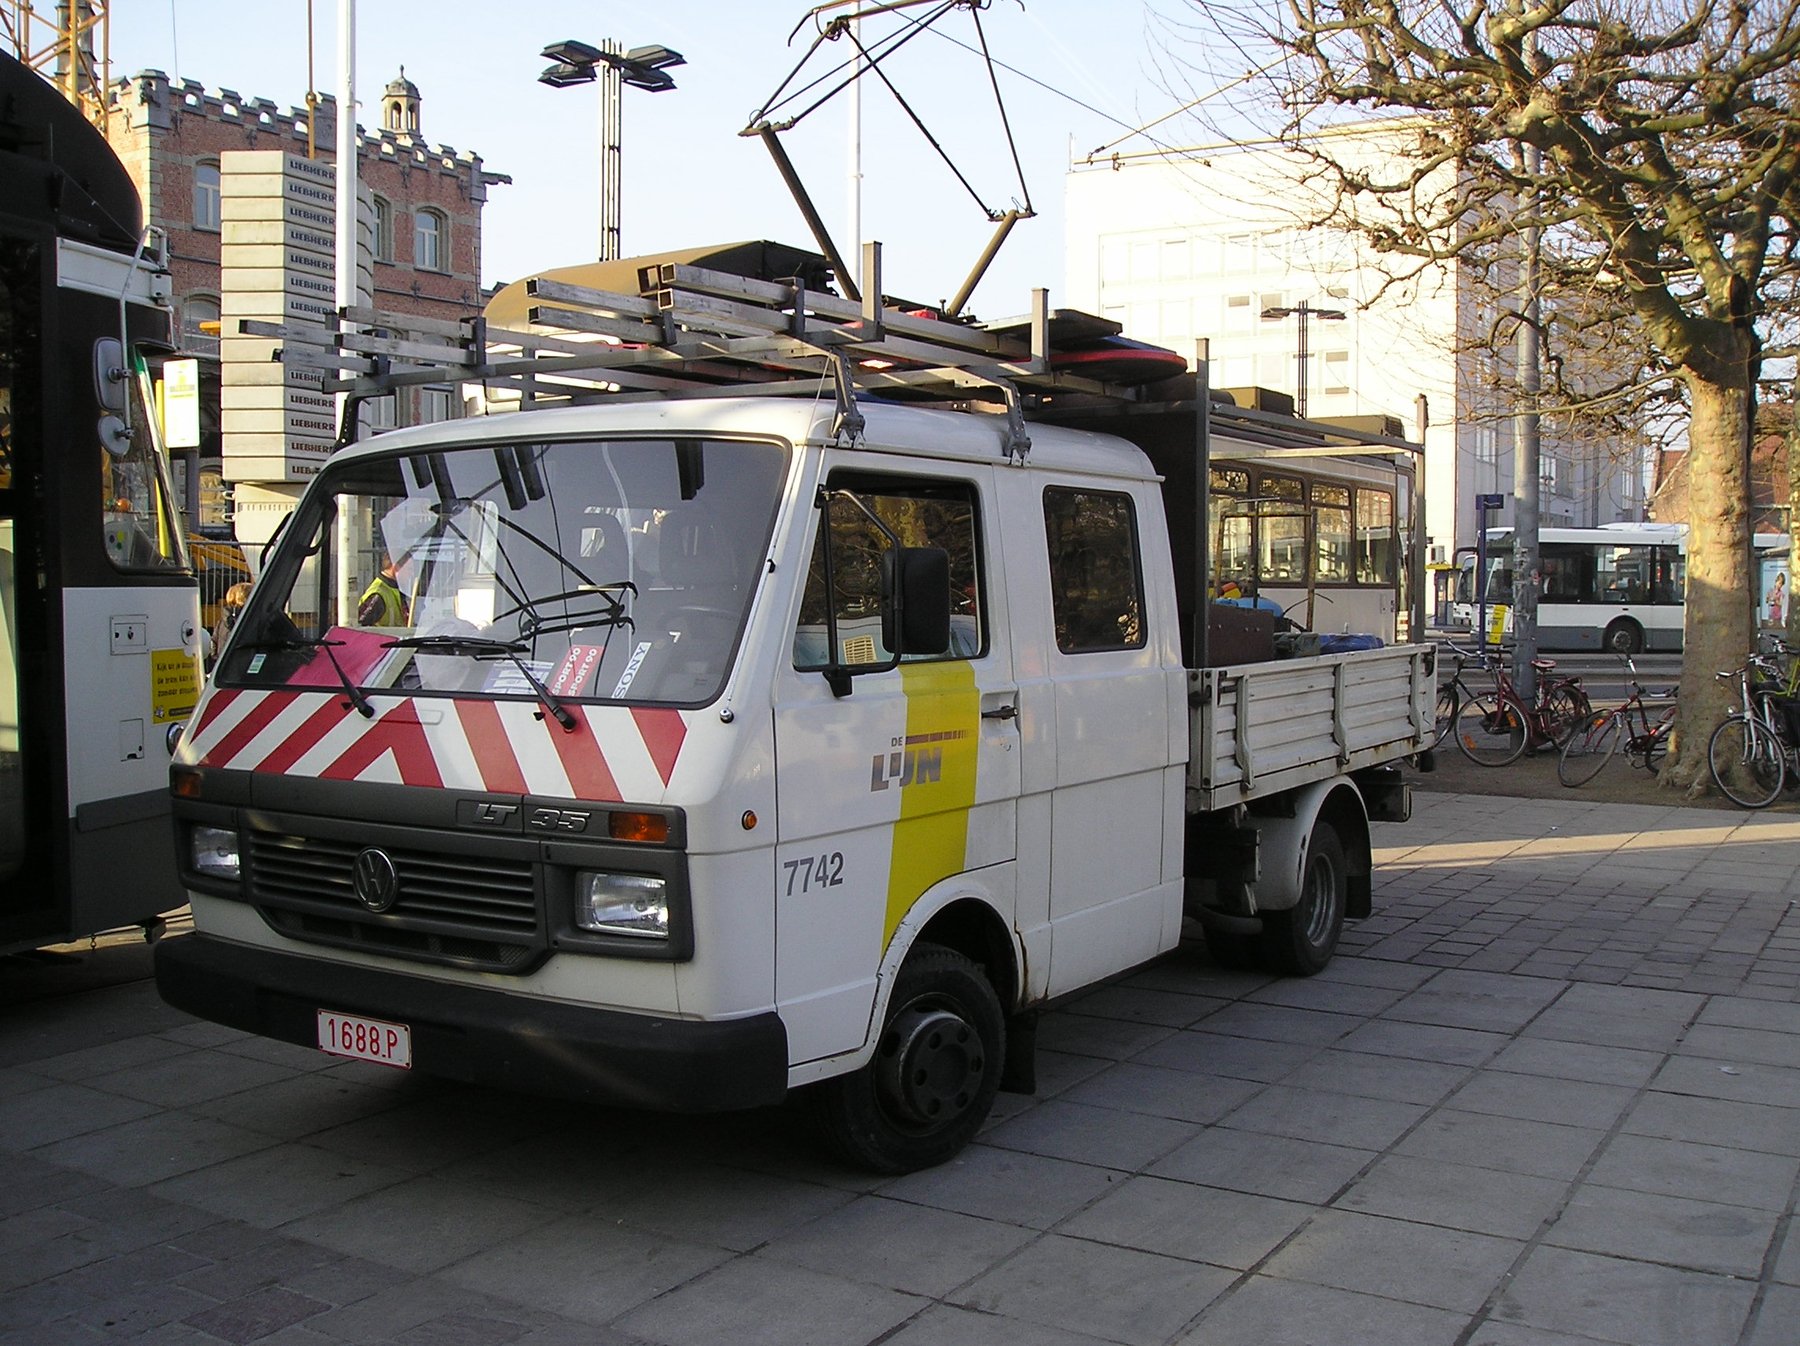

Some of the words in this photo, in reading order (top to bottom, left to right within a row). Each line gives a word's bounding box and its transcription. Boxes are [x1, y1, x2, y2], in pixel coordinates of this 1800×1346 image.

[290, 160, 336, 180] LIEBHERR
[290, 184, 336, 203] LIEBHERR
[290, 207, 336, 225] LIEBHERR
[290, 231, 336, 249] LIEBHERR
[290, 254, 336, 272] LIEBHERR
[290, 277, 336, 294] LIEBHERR
[291, 371, 323, 383] LIEBHE
[290, 395, 336, 408] LIEBHERR
[290, 418, 336, 432] LIEBHERR
[552, 664, 573, 695] SPORT
[569, 647, 582, 662] 90
[568, 664, 590, 697] SPORT
[585, 648, 598, 663] 90
[613, 646, 647, 698] SONY
[891, 736, 903, 747] DE
[871, 747, 943, 793] LIJN
[473, 803, 519, 825] LT
[531, 808, 591, 833] 35
[783, 851, 845, 896] 7742
